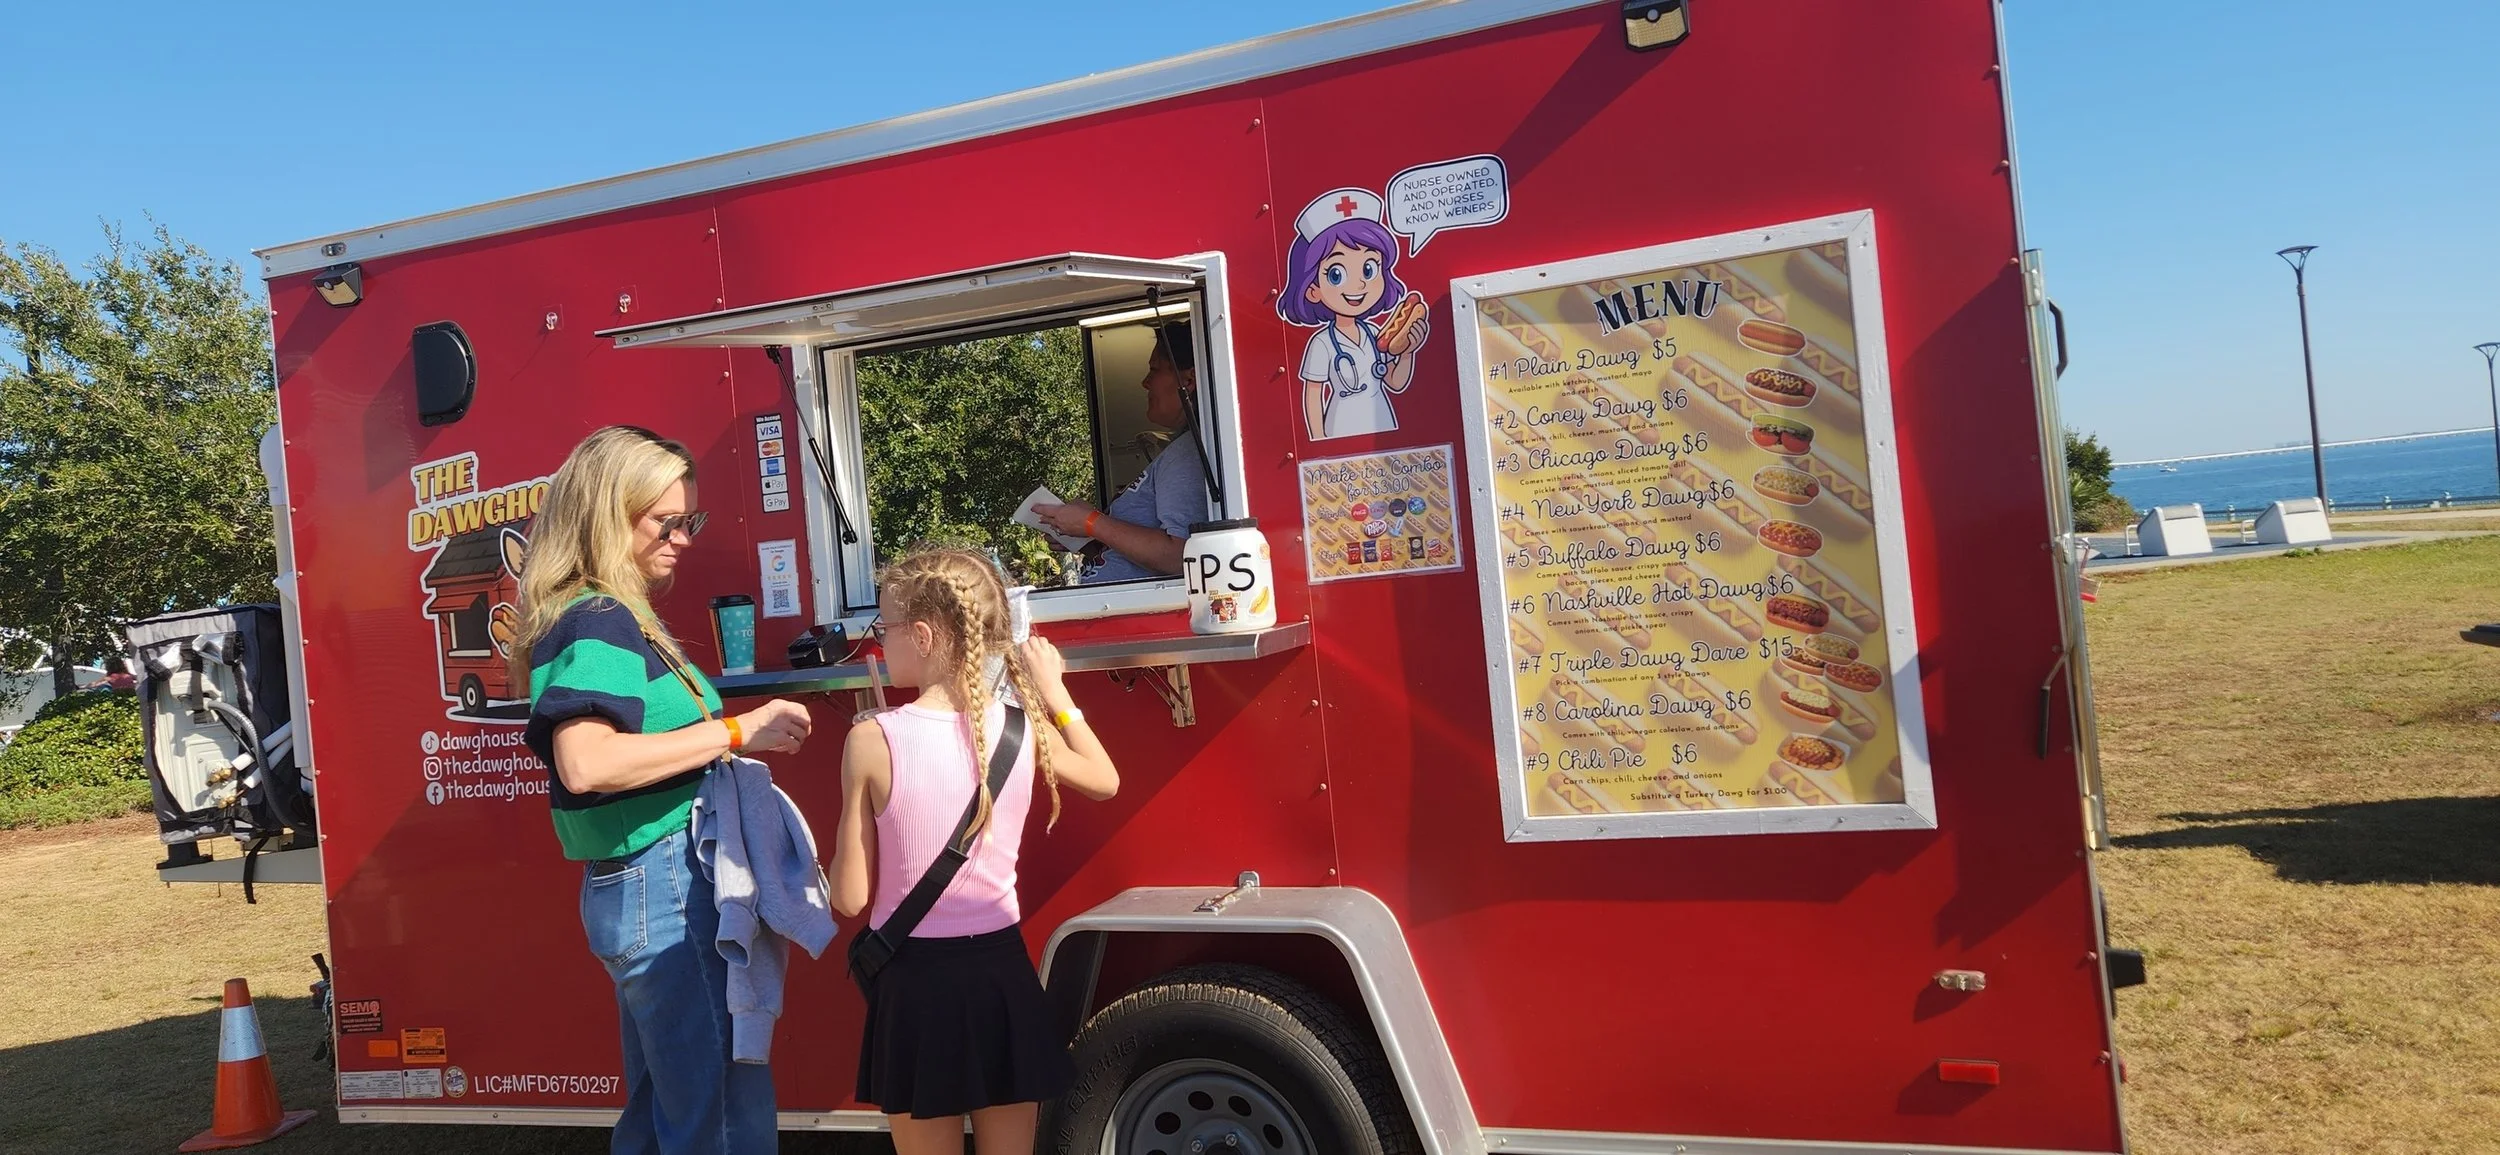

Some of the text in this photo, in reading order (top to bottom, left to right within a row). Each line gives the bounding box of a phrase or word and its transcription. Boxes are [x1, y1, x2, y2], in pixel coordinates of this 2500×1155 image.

[1404, 167, 1490, 190] NURSE OWNED
[1404, 191, 1426, 202] AND
[1411, 192, 1484, 212] AND NURSES
[1406, 202, 1494, 225] KNOW WEINERS
[1594, 279, 1723, 335] MENU
[1489, 337, 1676, 380] #1 Plain Dawg $5
[1508, 384, 1542, 394] Available
[1545, 382, 1560, 390] with
[1632, 370, 1652, 379] mayo
[1578, 387, 1598, 395] relish
[1494, 388, 1688, 429] #2 Coney Dawg $6
[760, 426, 779, 436] VISA
[1505, 438, 1528, 446] Comes
[1598, 425, 1629, 435] mustard
[1649, 421, 1673, 429] onions
[1497, 431, 1708, 472] #3 Chicago Dawg $6
[415, 457, 474, 503] THE
[1309, 456, 1443, 485] Make it a Combo
[1520, 478, 1544, 486] Comes
[1618, 466, 1638, 474] sliced
[772, 480, 784, 488] Pay
[1347, 477, 1410, 502] for $3.00
[1534, 486, 1556, 495] pickle
[1584, 481, 1614, 490] mustard
[1616, 478, 1631, 486] and
[1634, 476, 1656, 486] celery
[1659, 474, 1673, 482] salt
[1501, 502, 1525, 520] #4
[1642, 486, 1707, 508] Dawg
[1708, 478, 1734, 501] $6
[1525, 529, 1549, 537] Comes
[1552, 526, 1567, 534] with
[1660, 514, 1692, 522] mustard
[1506, 531, 1721, 569] #5 Buffalo Dawg $6
[1562, 568, 1578, 576] with
[1581, 566, 1609, 574] buffalo
[1637, 561, 1659, 571] crispy
[1510, 574, 1793, 614] #6 Nashville Hot Dawg $6
[1547, 619, 1570, 627] Comes
[1592, 614, 1627, 623] Nashville
[1671, 609, 1693, 618] crispy
[1621, 623, 1642, 631] pickle
[1645, 622, 1666, 630] spear
[1519, 636, 1794, 676] #7 Triple Dawg Dare $15
[1556, 679, 1570, 687] Pick
[1581, 676, 1626, 684] combination
[1641, 674, 1654, 682] any
[1663, 672, 1682, 680] style
[1685, 670, 1710, 679] Dawgs
[1523, 690, 1751, 722] #8 Carolina Dawg $6
[1627, 727, 1656, 736] vinegar
[1713, 723, 1739, 731] onions
[444, 752, 547, 777] thedawghou
[1526, 744, 1697, 770] #9 Chili Pie $6
[1685, 791, 1714, 800] Turkey
[1718, 789, 1742, 799] Dawg
[1747, 788, 1760, 796] for
[474, 1075, 619, 1094] LIC#MFD6750297
